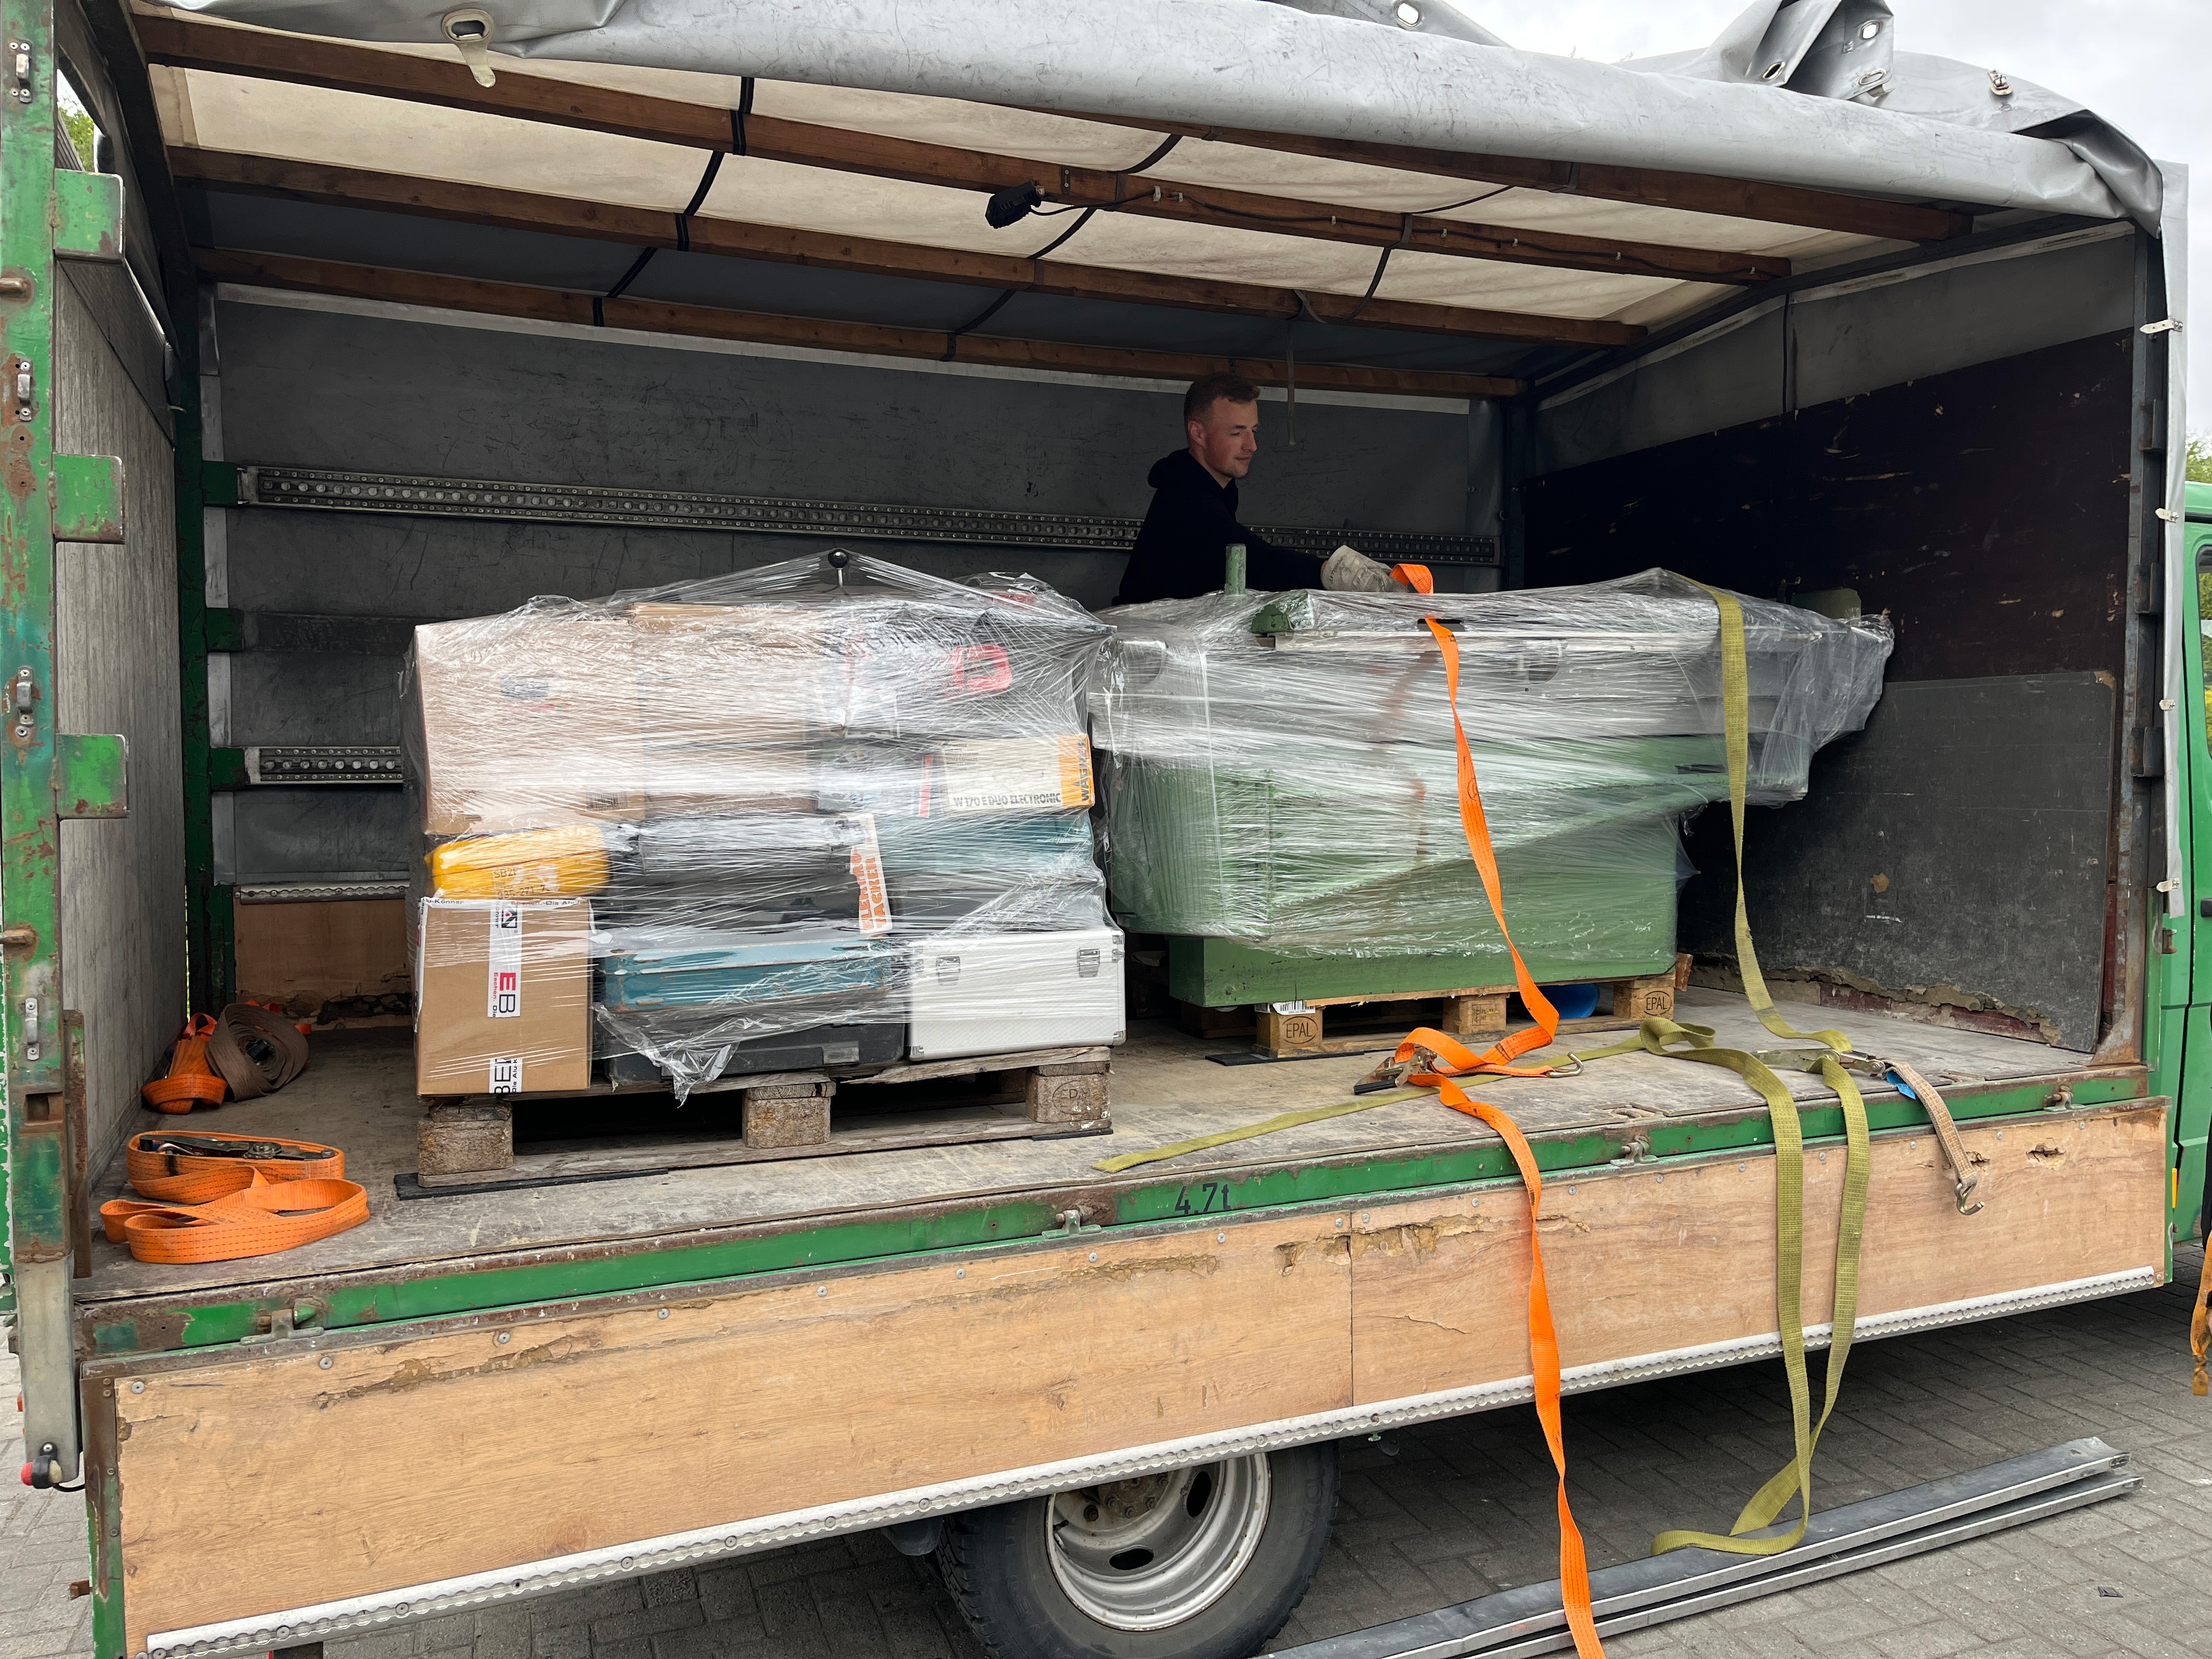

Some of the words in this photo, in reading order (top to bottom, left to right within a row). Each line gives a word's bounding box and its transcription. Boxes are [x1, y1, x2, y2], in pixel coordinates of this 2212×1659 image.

[1077, 737, 1090, 802] WAGNER
[964, 796, 980, 807] 170
[988, 794, 1008, 806] DUO
[1009, 793, 1062, 804] ELECTRONIC
[865, 856, 887, 929] TACKER
[1646, 996, 1668, 1011] EPAL
[1286, 1022, 1312, 1039] EPAL
